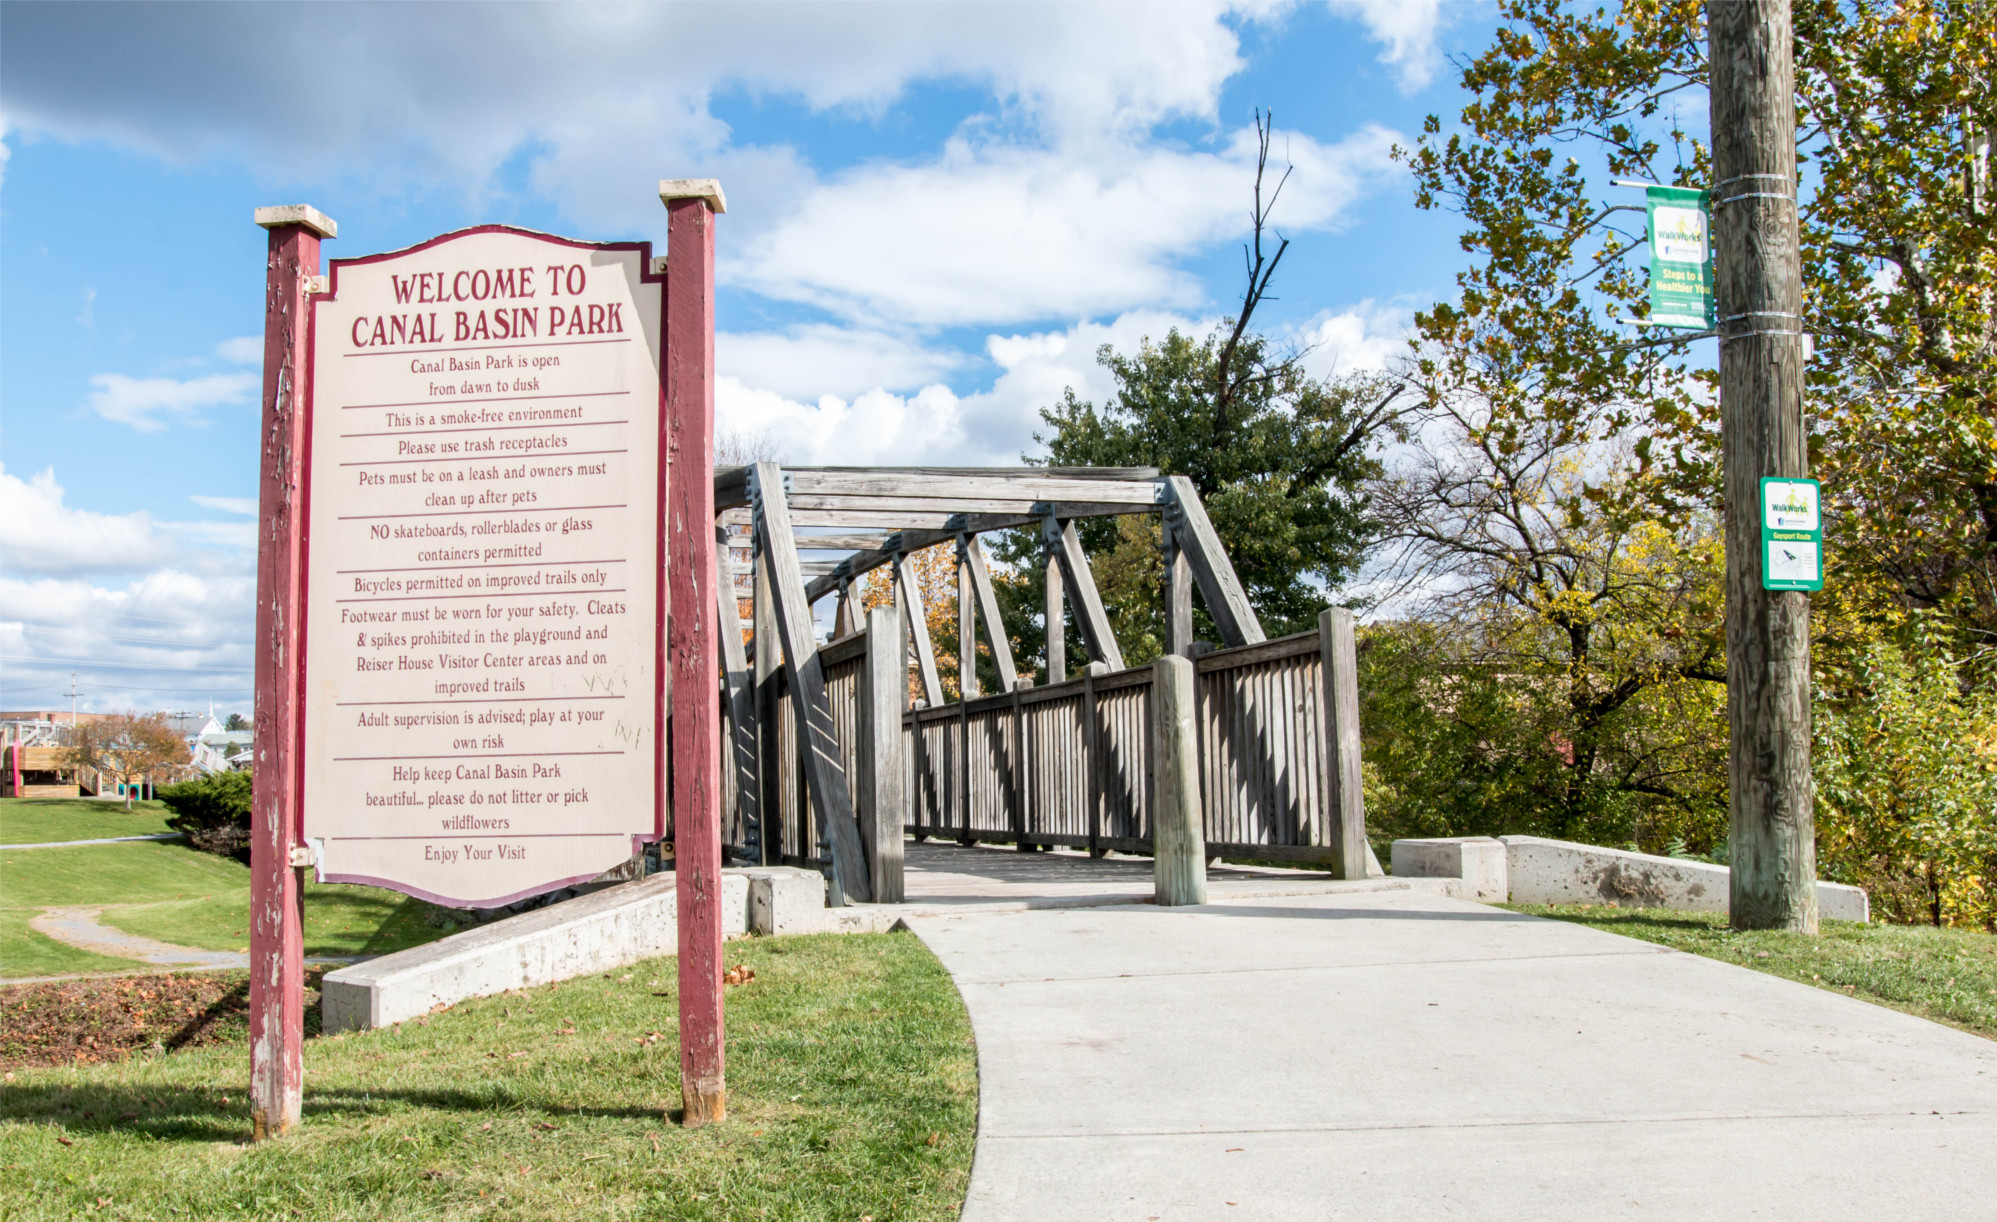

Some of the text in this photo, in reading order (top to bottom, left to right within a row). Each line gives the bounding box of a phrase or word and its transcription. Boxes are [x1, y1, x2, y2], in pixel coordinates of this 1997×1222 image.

[1658, 230, 1701, 242] WalkWorks
[391, 263, 587, 305] WELCOME TO
[1663, 269, 1685, 281] Steps
[1687, 270, 1696, 281] to
[1656, 280, 1710, 294] Healthier You
[351, 302, 624, 349] CANAL BASIN PARK
[410, 354, 561, 374] Canal Basin Park is open
[429, 376, 540, 397] from dawn to dusk
[385, 405, 583, 428] This is a smoke-free environment
[398, 433, 568, 456] Please use trash receptacles
[359, 461, 607, 486] Pets must be on a leash and owners must
[424, 488, 538, 509] clean up after pets
[1772, 504, 1807, 512] WalkWorks
[370, 516, 593, 540] NO skateboards, rollerblades or glass
[417, 541, 542, 563] containers permitted
[354, 568, 608, 596] Bicycles permitted on improved trails only
[341, 599, 626, 624] Footwear must be worn for your safety. Cleats
[356, 624, 608, 651] & spikes prohibited in the playground and
[356, 649, 608, 672] Reiser House Visitor Center areas and on
[435, 676, 526, 698] improved trails
[357, 707, 605, 730] Adult supervision is advised; play at your
[453, 733, 505, 750] own risk
[392, 762, 561, 785] Help keep Canal Basin Park
[366, 787, 589, 810] beautiful... please do not litter or pick
[441, 814, 510, 830] wildflowers
[424, 844, 526, 865] Enjoy Your Visit
